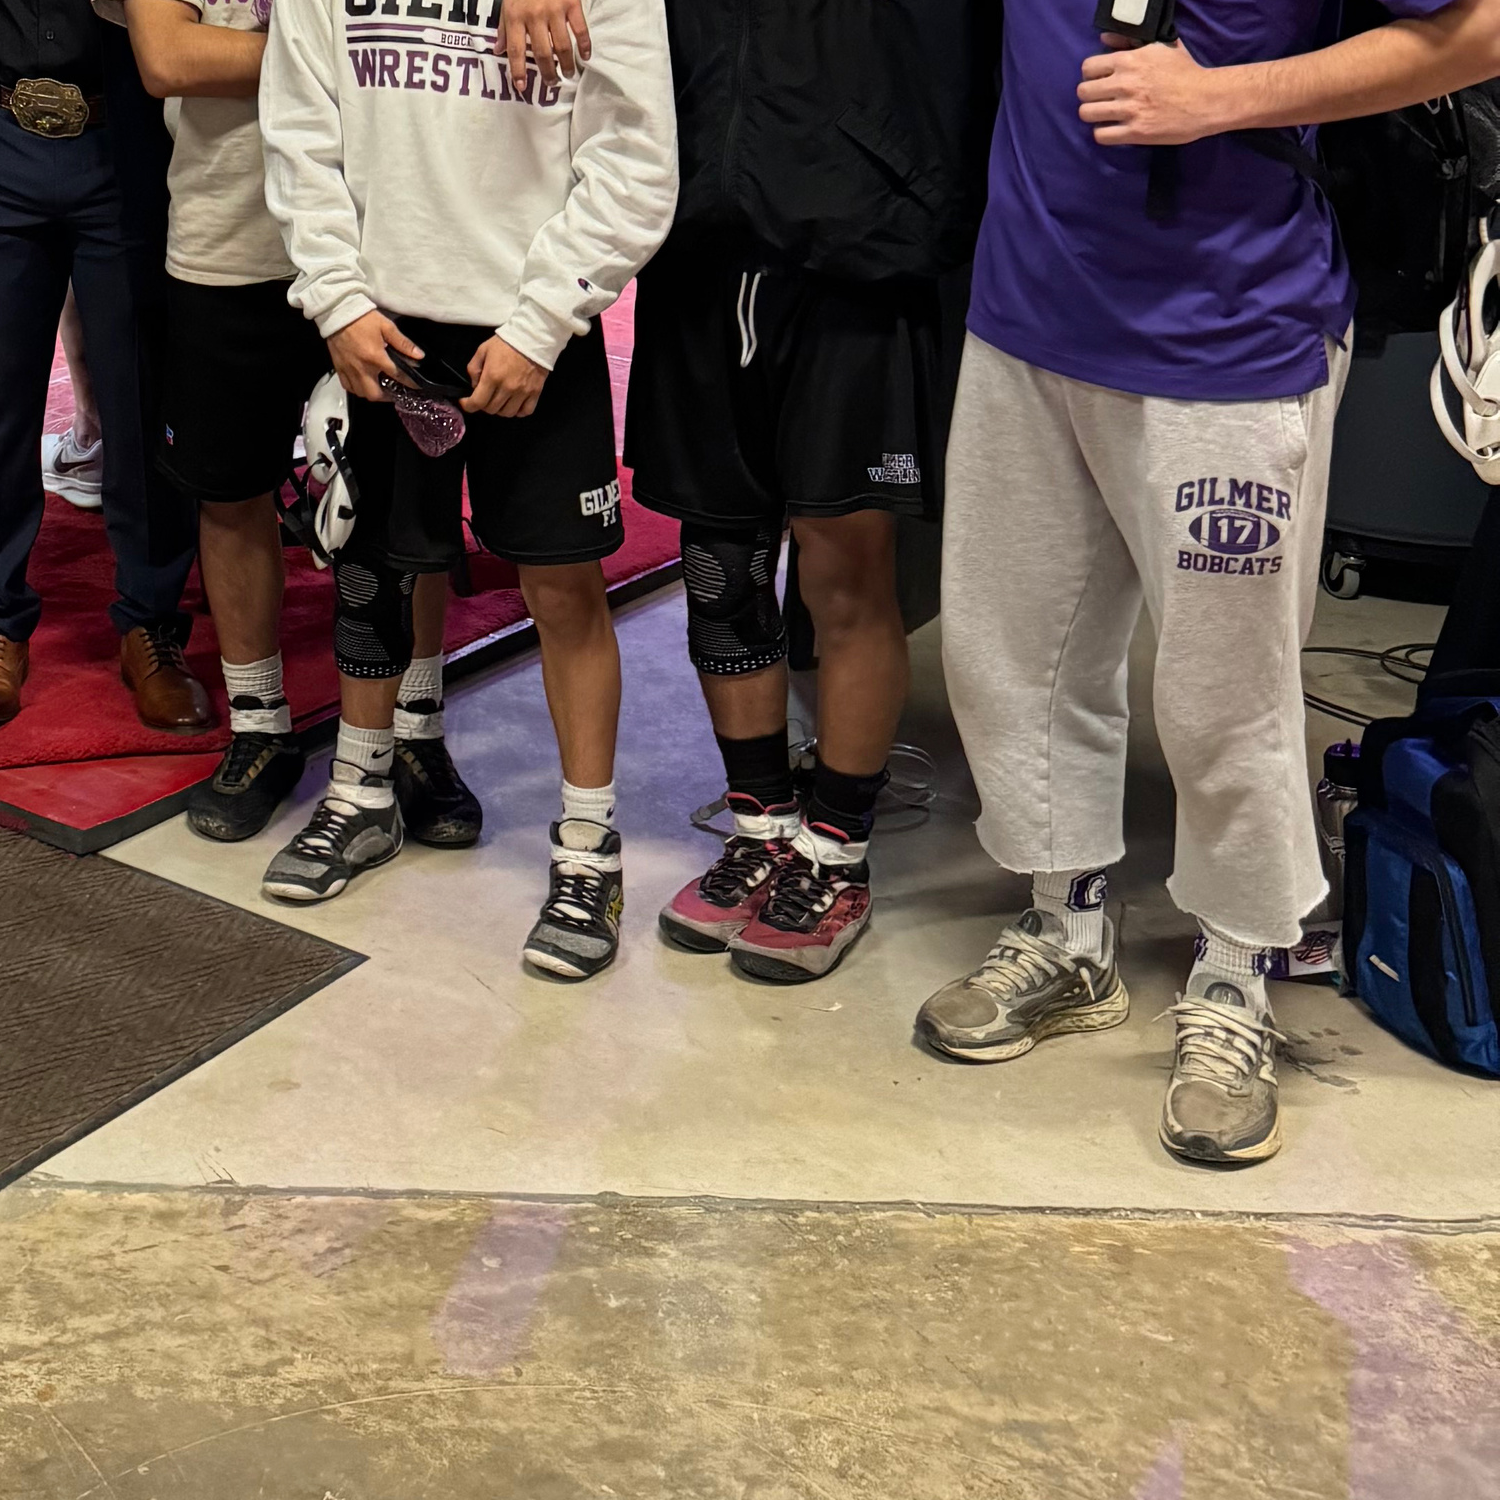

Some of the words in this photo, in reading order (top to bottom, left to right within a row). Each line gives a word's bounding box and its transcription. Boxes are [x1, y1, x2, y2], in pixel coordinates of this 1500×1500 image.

[1174, 477, 1292, 521] GILMER
[1216, 517, 1254, 544] 17
[1176, 550, 1283, 576] BOBCATS
